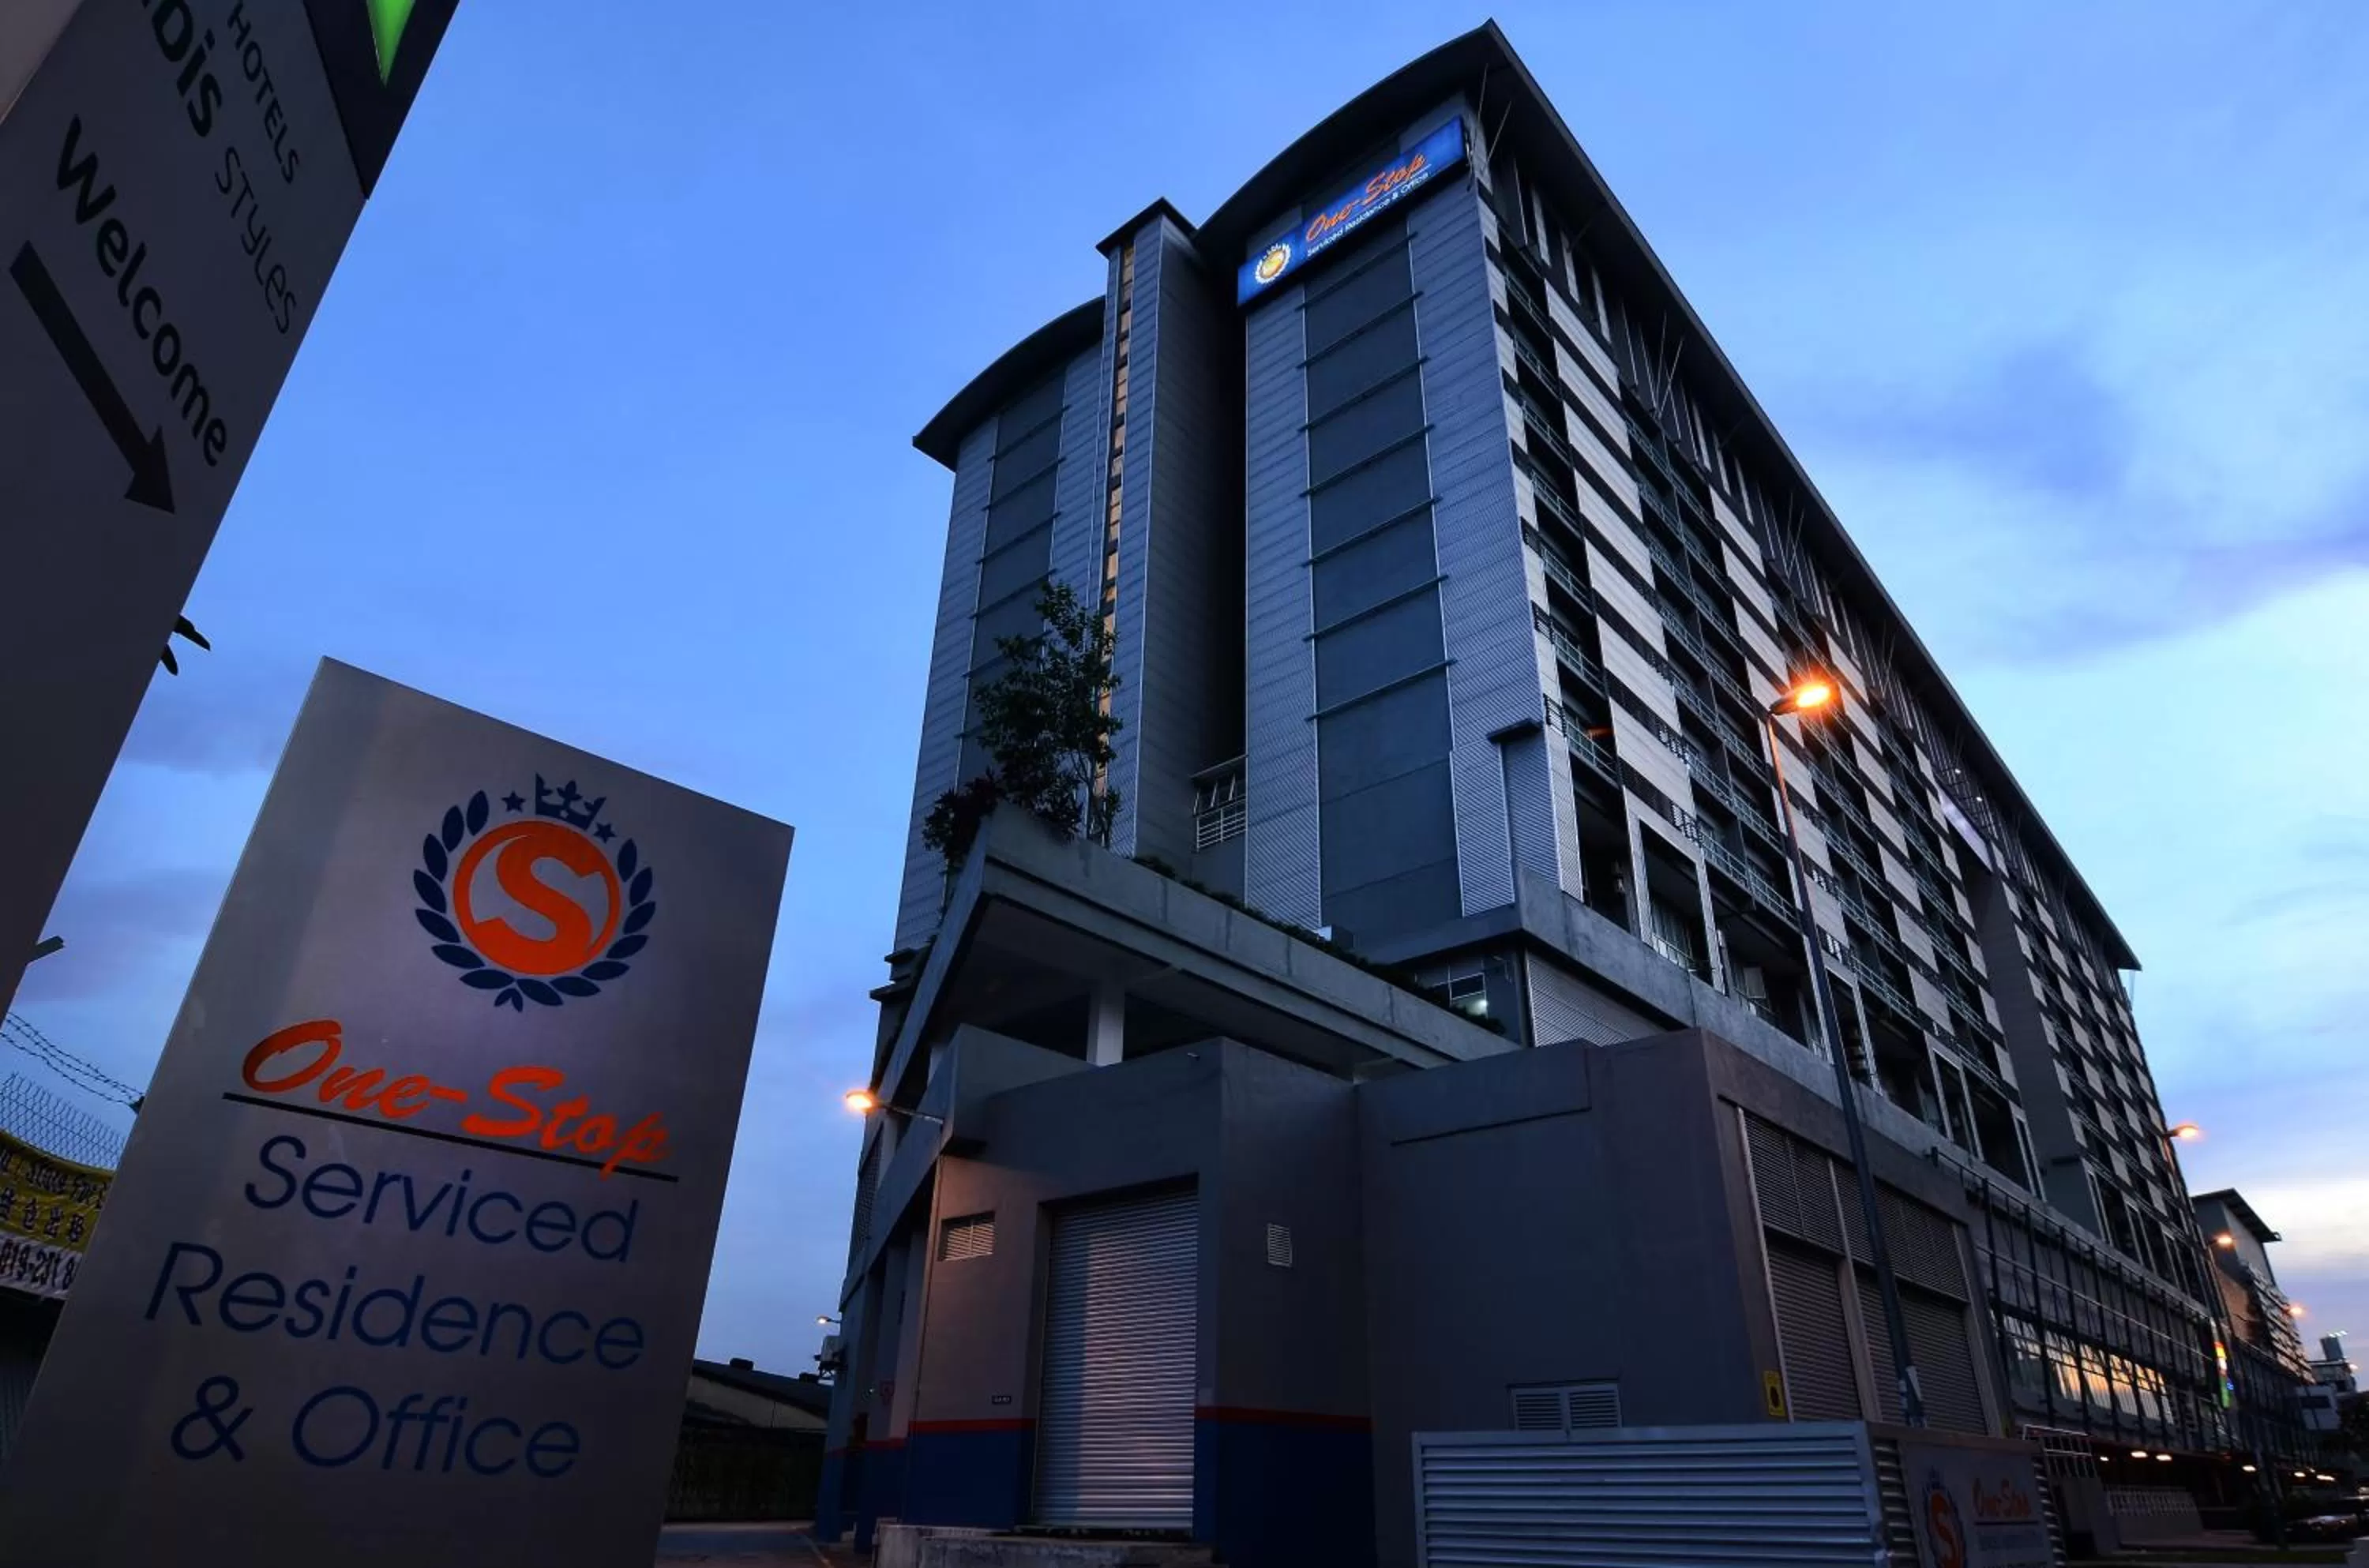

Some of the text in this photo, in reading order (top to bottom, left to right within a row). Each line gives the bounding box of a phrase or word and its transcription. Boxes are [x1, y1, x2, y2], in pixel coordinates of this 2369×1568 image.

[141, 0, 223, 137] bis
[227, 0, 301, 184] HOTELS
[1305, 153, 1427, 242] One-Stop
[57, 113, 227, 467] Welcome
[242, 1019, 674, 1182] One-Stop
[244, 1135, 640, 1263] Serviced
[145, 1241, 645, 1371] Residence
[171, 1375, 580, 1478] & Office
